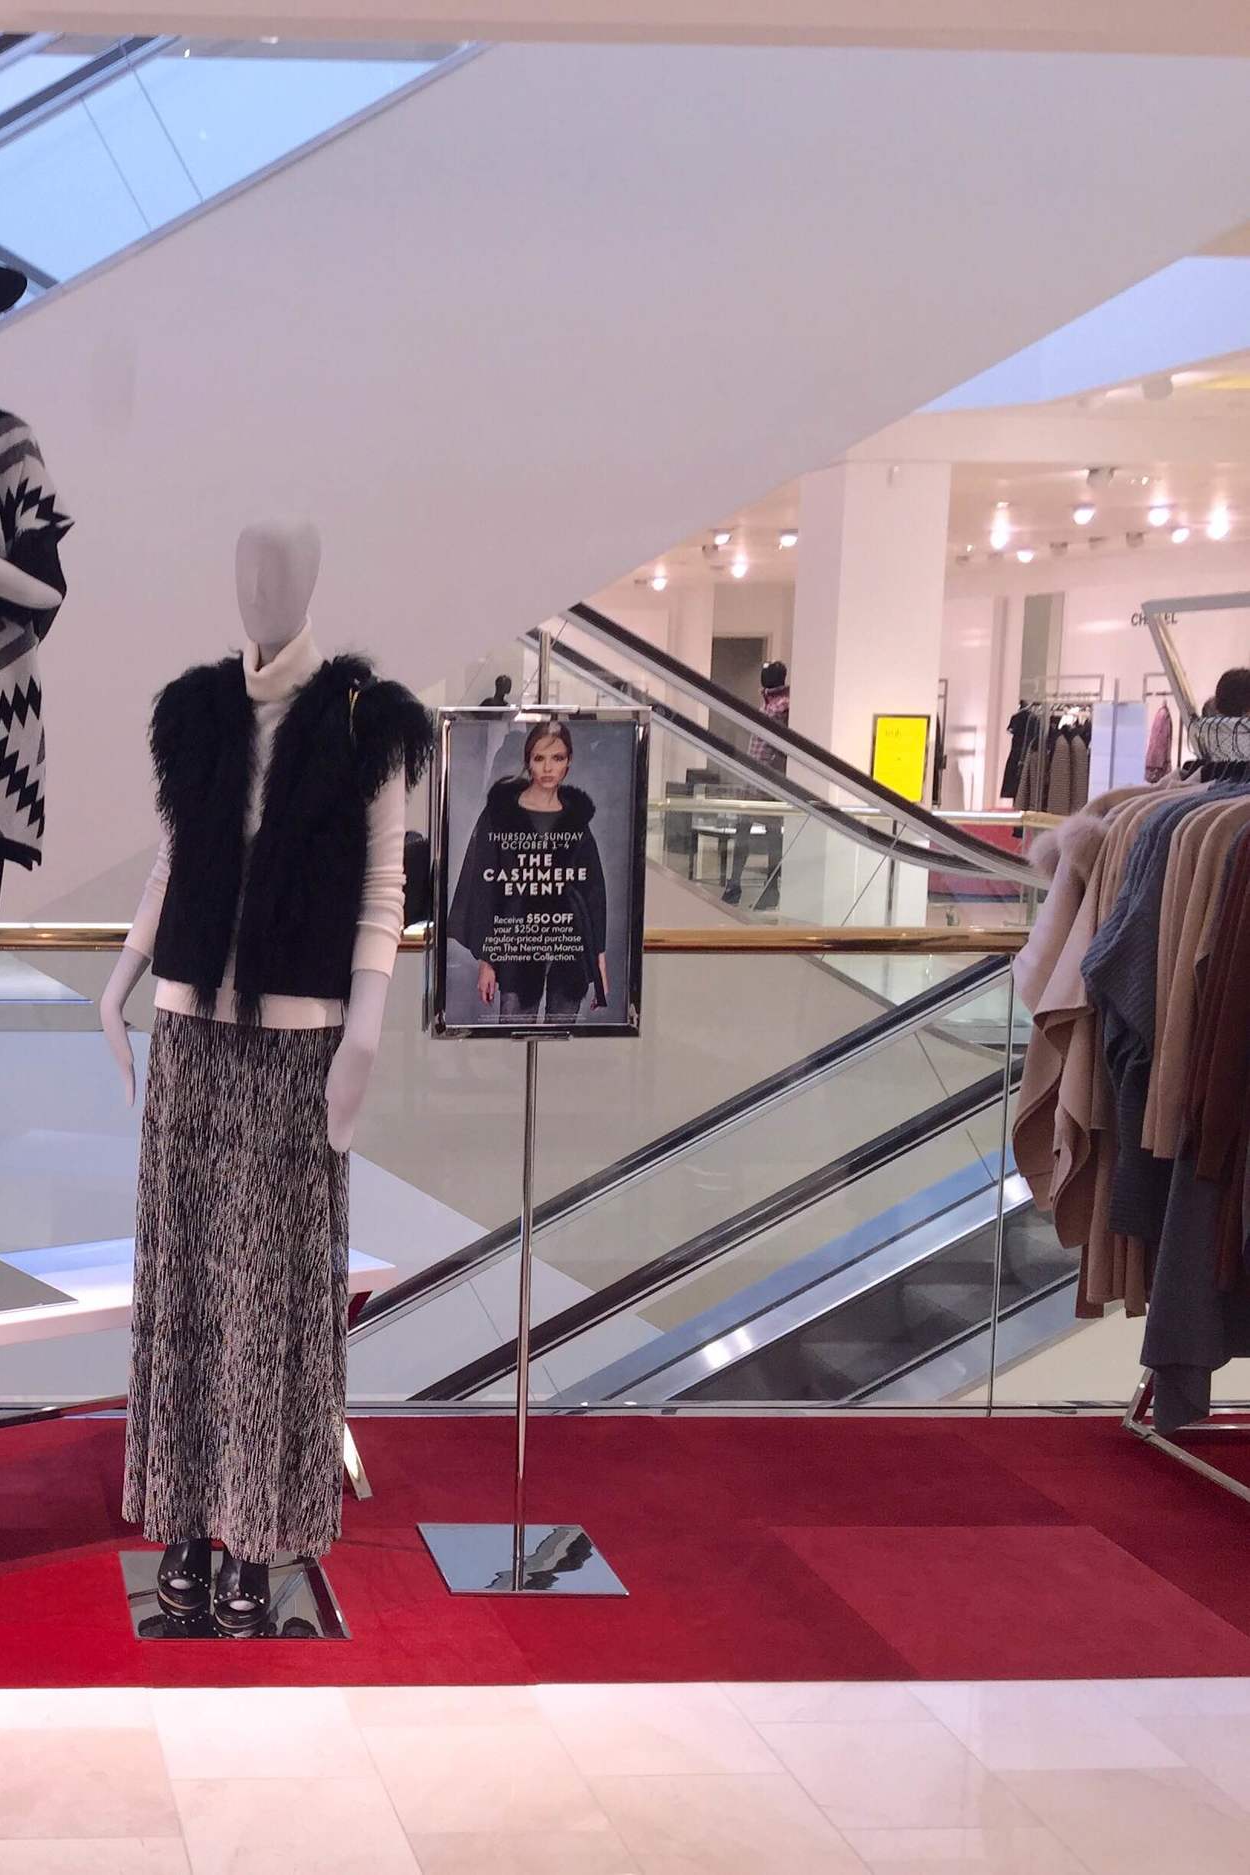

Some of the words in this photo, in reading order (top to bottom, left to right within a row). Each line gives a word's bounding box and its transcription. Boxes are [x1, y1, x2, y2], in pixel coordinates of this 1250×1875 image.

[1130, 612, 1178, 626] CHEL
[501, 840, 548, 850] OCTOBER
[517, 854, 553, 867] THE
[483, 868, 587, 882] CASHMERE
[504, 883, 565, 896] EVENT
[493, 915, 524, 925] Receive
[526, 913, 551, 925] $50
[552, 913, 574, 924] OFF
[493, 926, 512, 935] your
[514, 924, 540, 934] $250
[541, 926, 550, 934] or
[485, 935, 543, 944] regular-priced
[544, 934, 582, 943] purchase
[482, 944, 502, 953] from
[503, 944, 518, 953] The
[519, 943, 552, 952] Neiman
[553, 943, 584, 952] Marcus
[490, 953, 531, 962] Cashmere
[532, 952, 576, 962] Collection.
